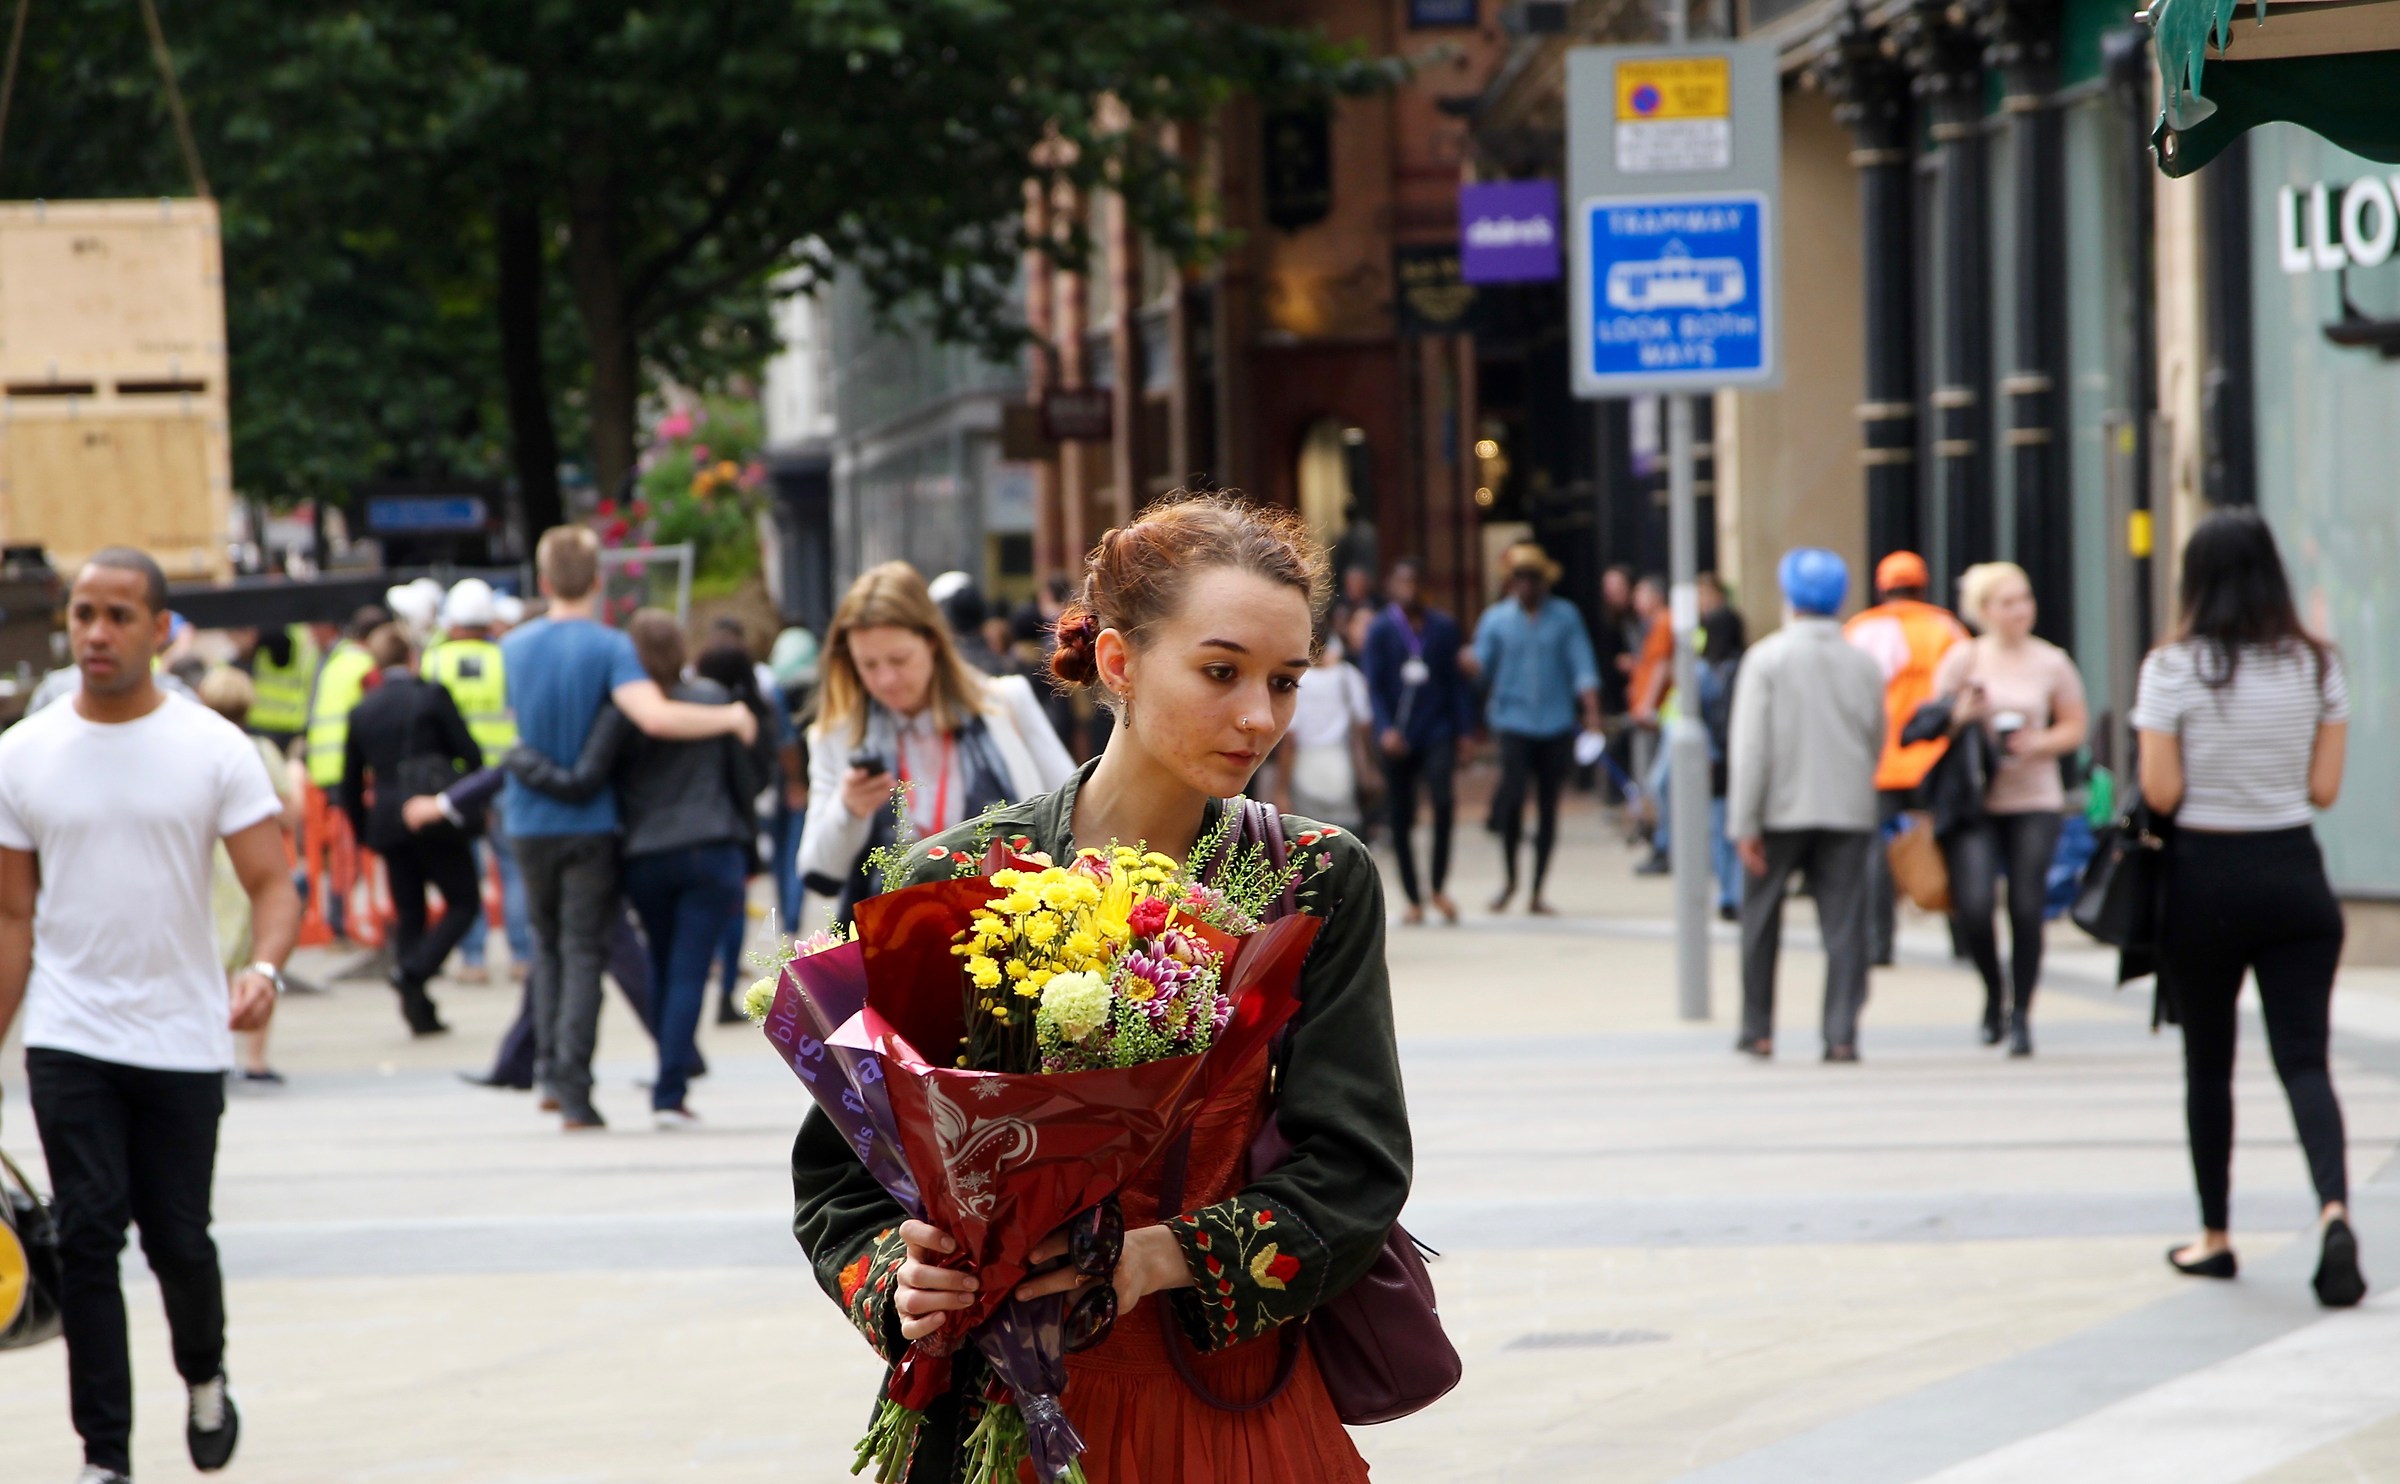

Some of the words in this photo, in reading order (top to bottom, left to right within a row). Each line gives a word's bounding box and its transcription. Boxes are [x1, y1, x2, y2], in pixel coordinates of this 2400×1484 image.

[1608, 208, 1743, 236] TRAMWAY
[2279, 173, 2400, 273] LLO
[1598, 315, 1671, 342] LOOK
[1679, 311, 1756, 340] BOTH
[1638, 342, 1718, 369] WAYS
[772, 982, 799, 1045] bloo
